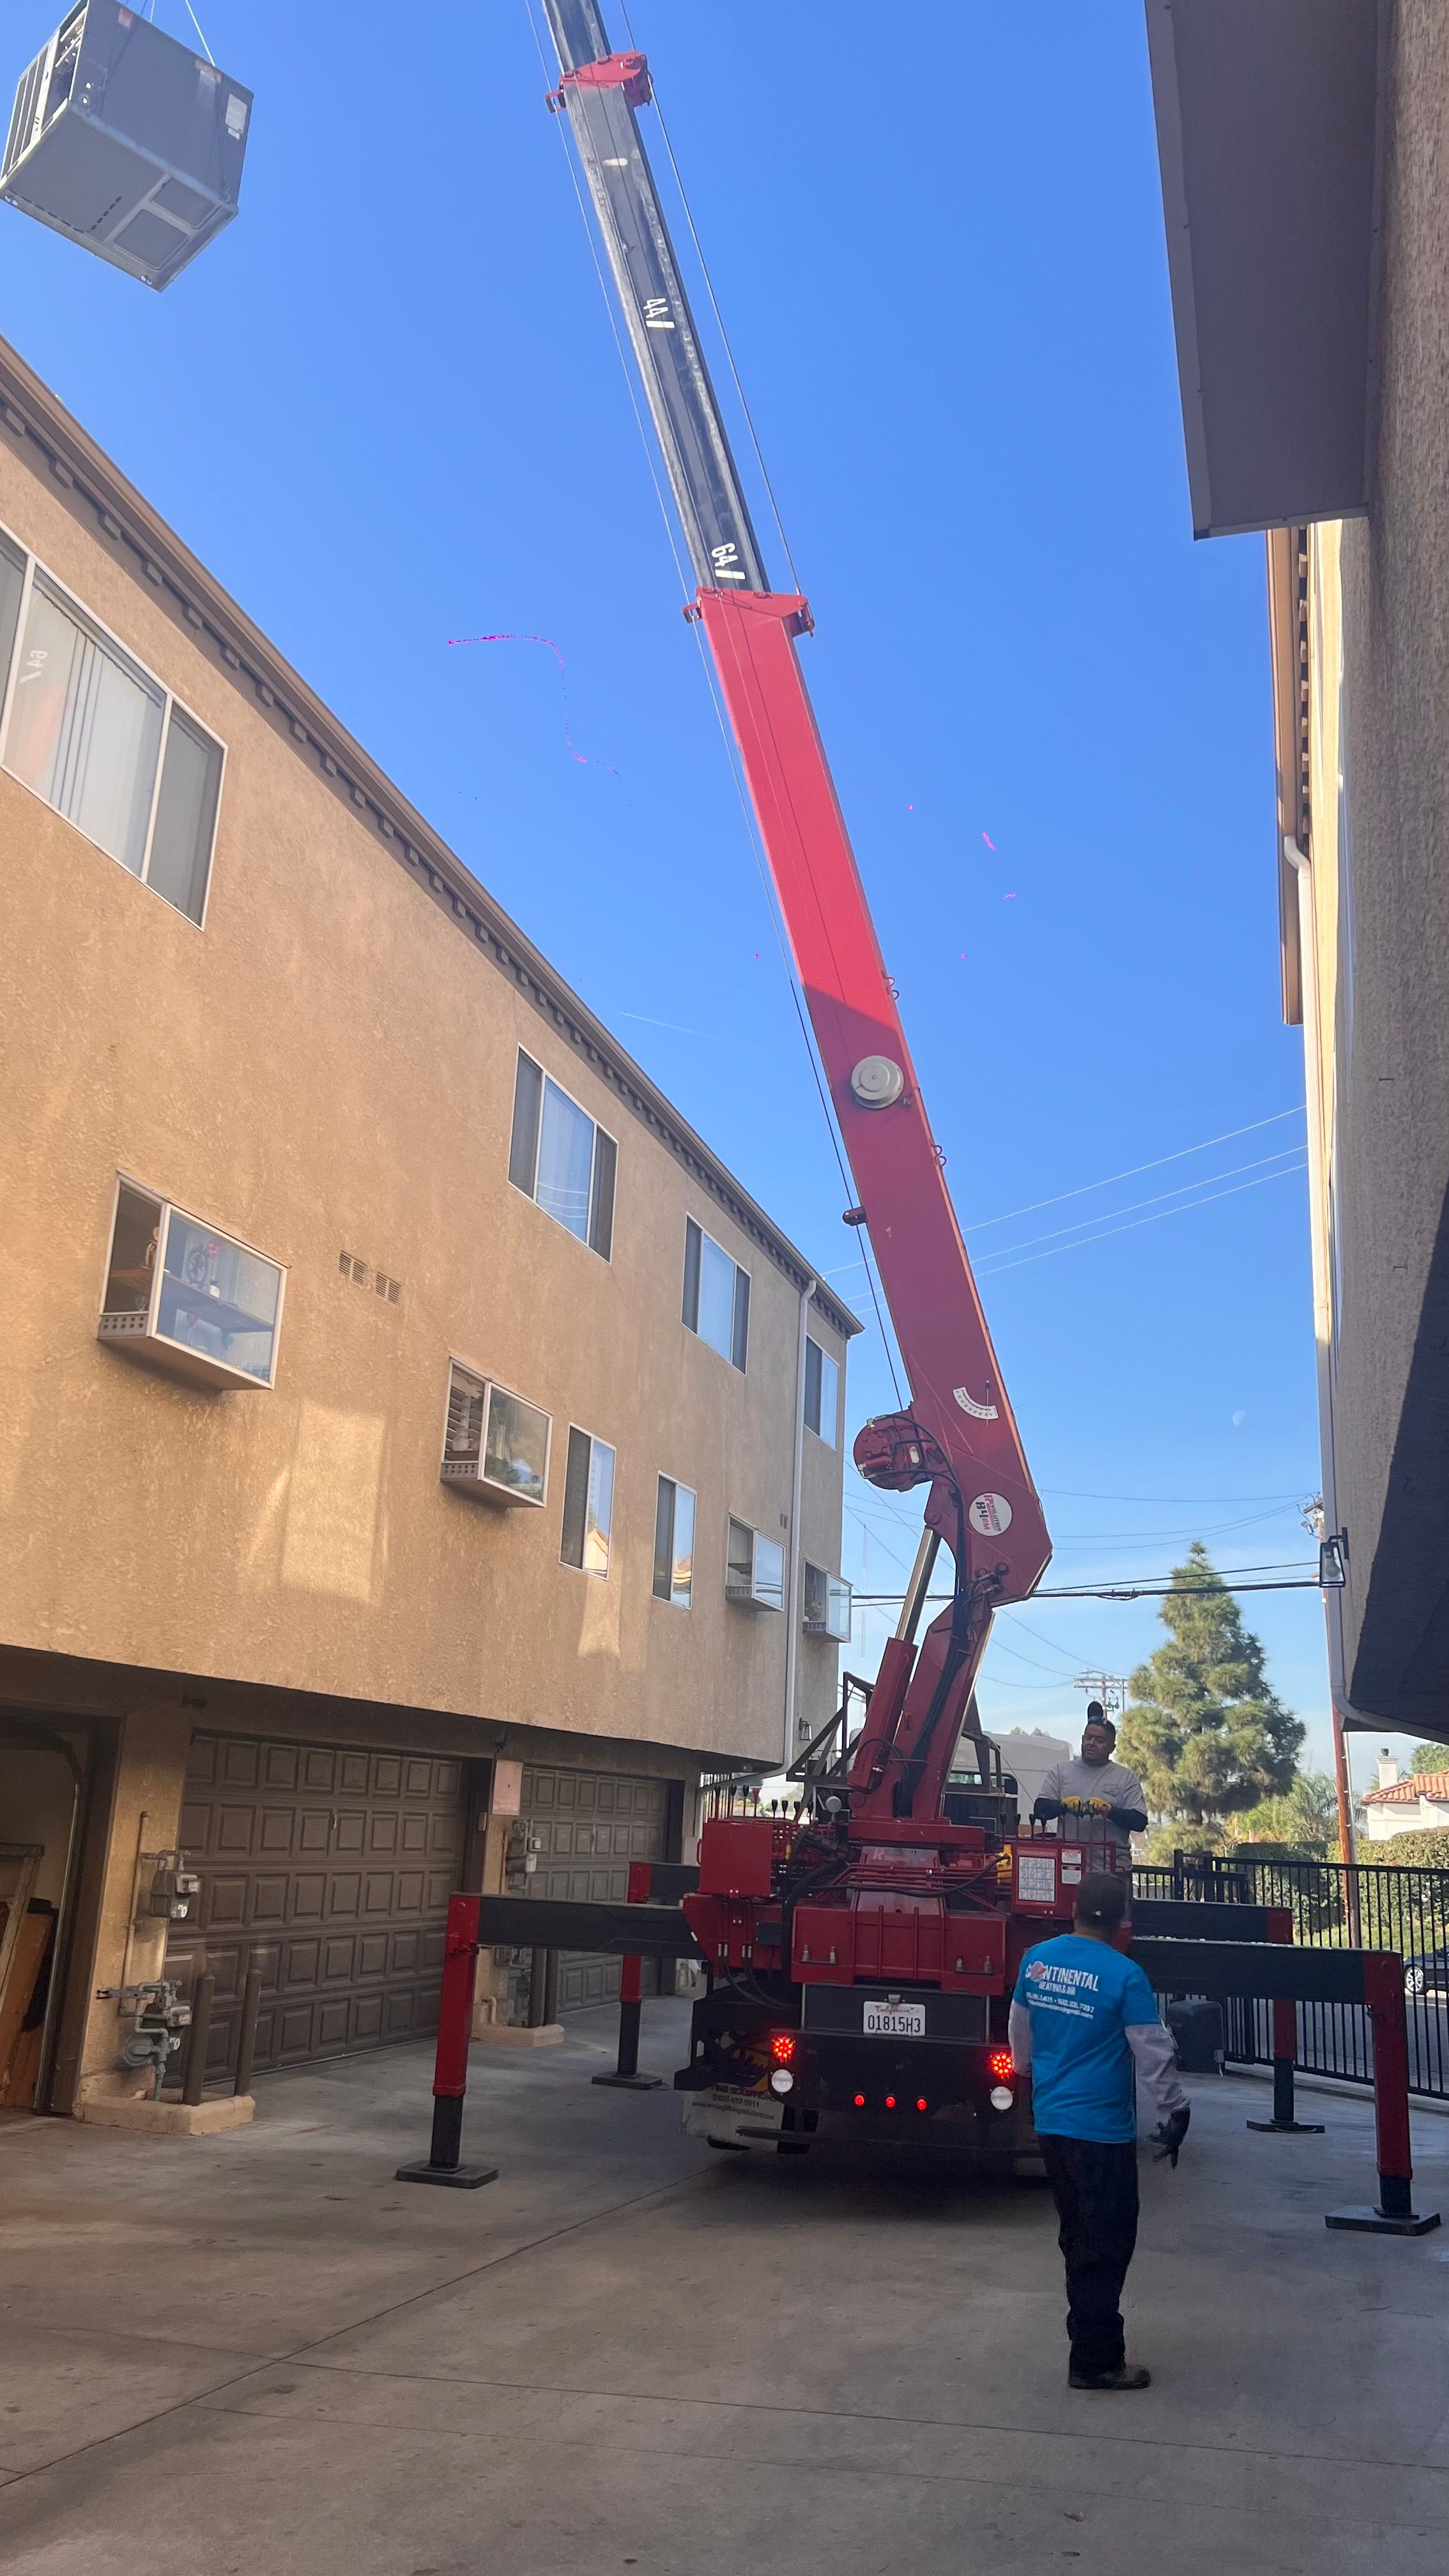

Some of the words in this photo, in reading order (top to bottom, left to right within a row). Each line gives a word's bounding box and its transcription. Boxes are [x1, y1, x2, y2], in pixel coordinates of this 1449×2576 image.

[643, 298, 669, 319] 44
[711, 542, 739, 567] 64
[876, 2005, 912, 2015] California
[868, 2014, 921, 2033] 01815H3
